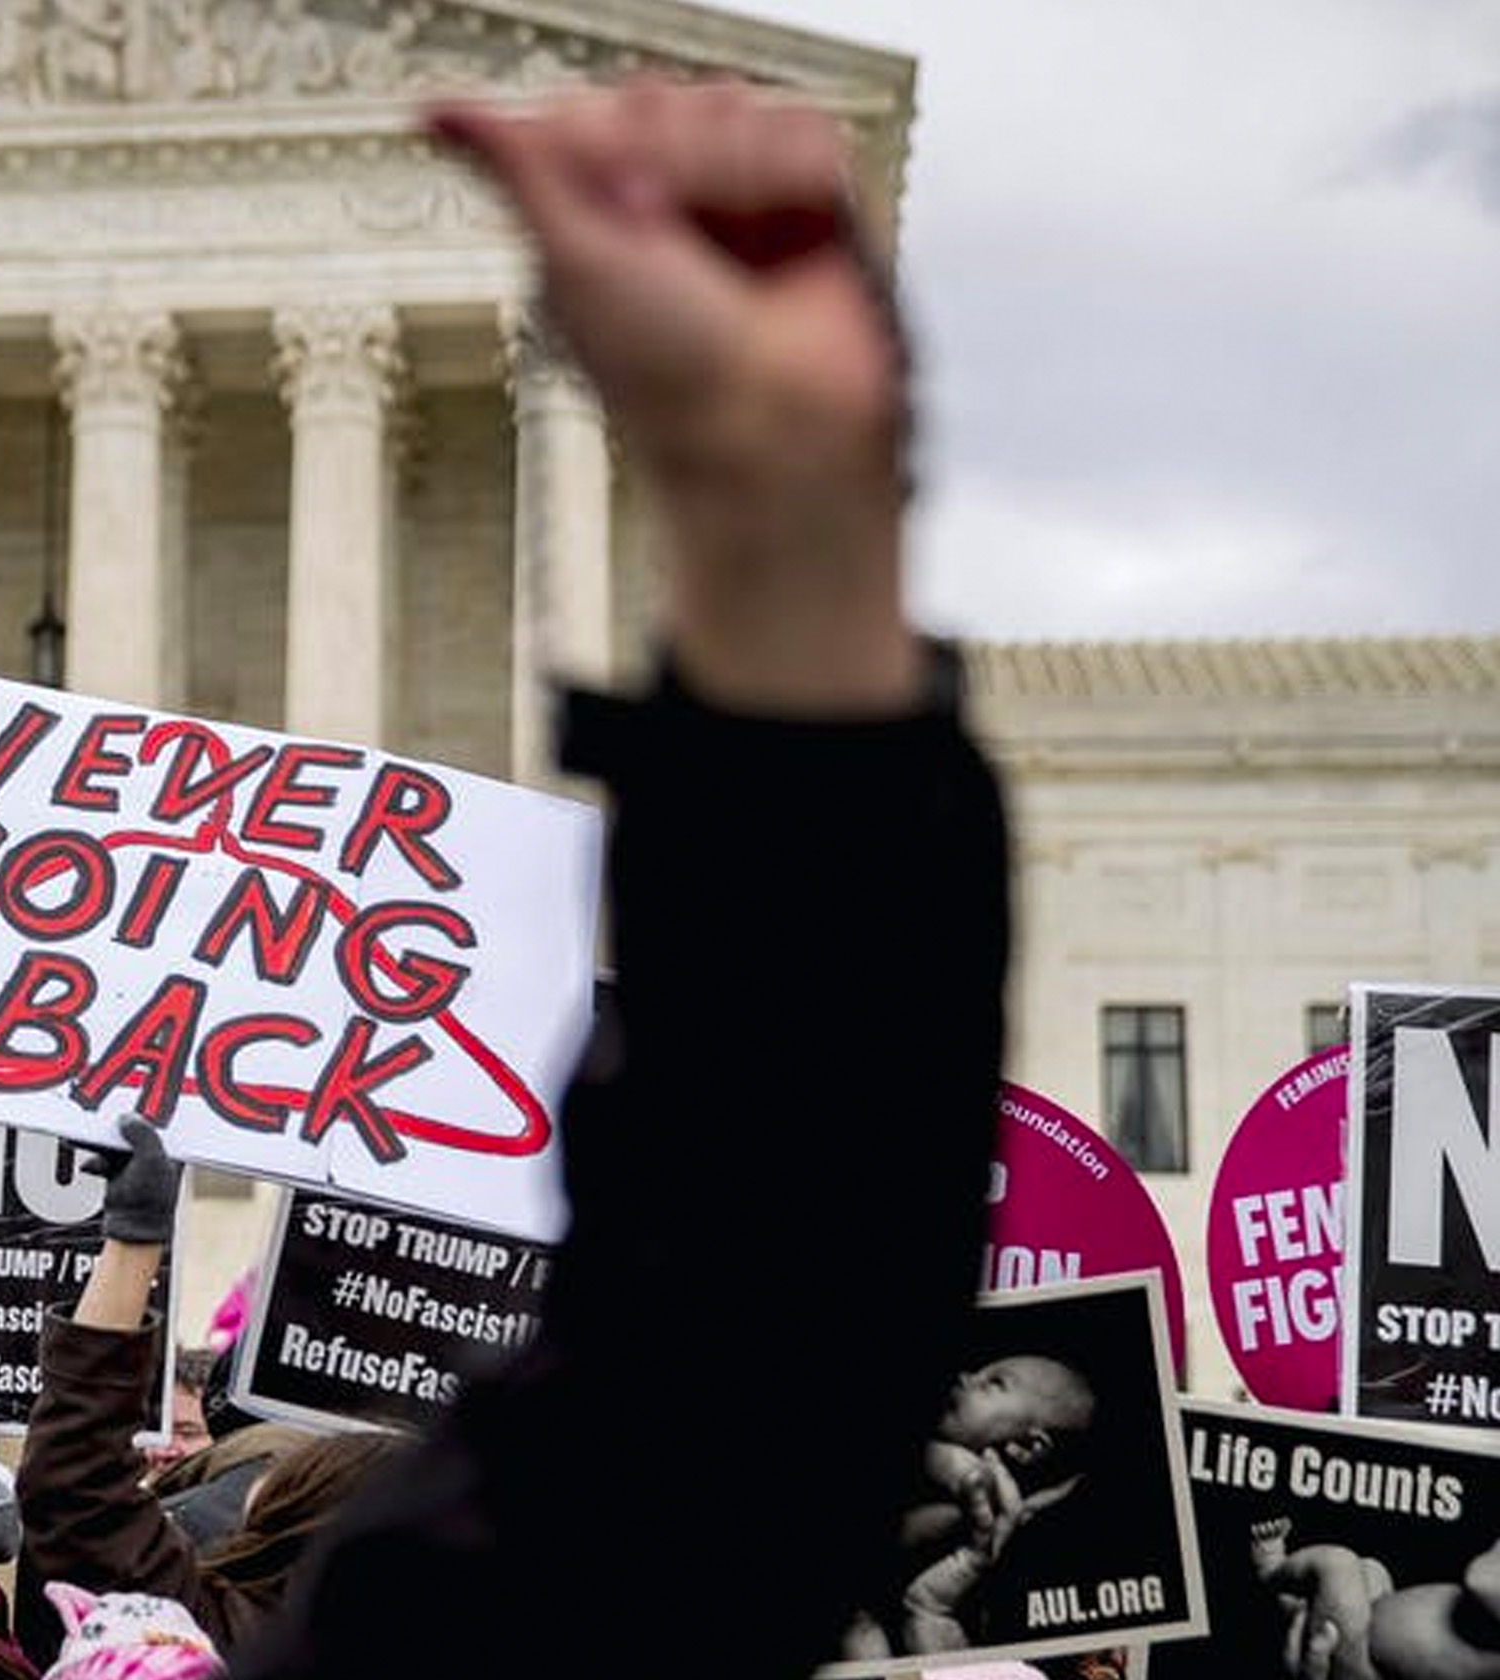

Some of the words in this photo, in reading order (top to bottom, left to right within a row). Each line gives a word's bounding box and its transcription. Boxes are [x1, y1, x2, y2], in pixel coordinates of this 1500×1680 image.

[997, 1098, 1111, 1181] oundation
[303, 1202, 390, 1249] STOP
[396, 1224, 509, 1279] TRUMP
[1377, 1303, 1477, 1348] STOP
[1190, 1429, 1277, 1490] Life
[1290, 1445, 1464, 1522] Counts
[1026, 1576, 1165, 1628] AUL.ORG
